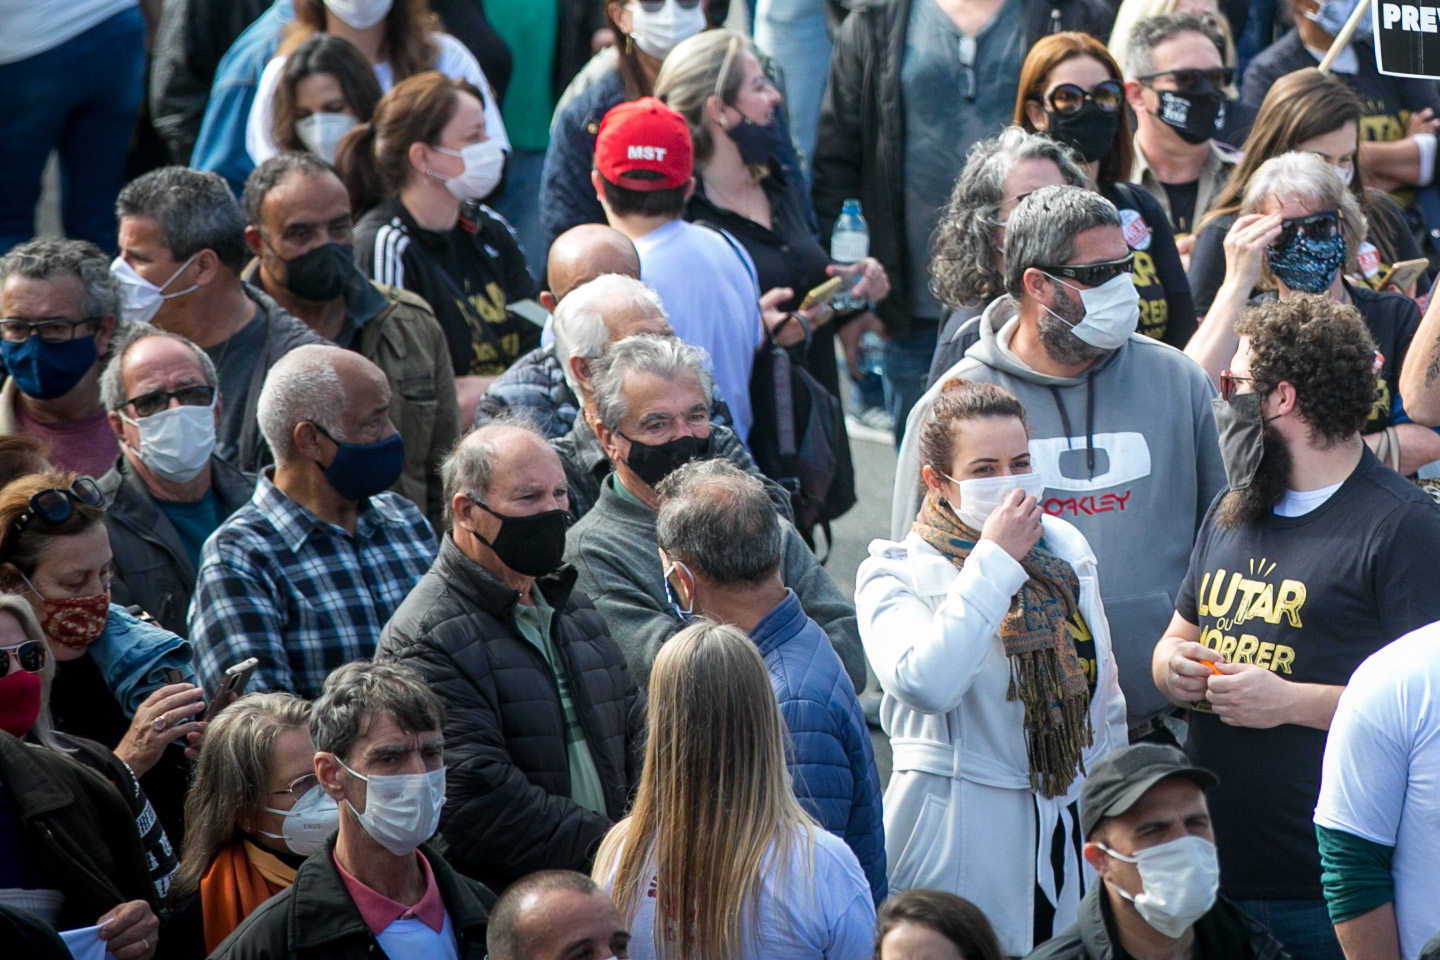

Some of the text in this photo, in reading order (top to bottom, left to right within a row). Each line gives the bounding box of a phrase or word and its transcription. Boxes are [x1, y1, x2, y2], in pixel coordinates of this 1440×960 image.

[627, 145, 667, 162] MST
[1043, 490, 1131, 516] OAKLEY
[1199, 568, 1307, 628] LUTAR
[1216, 617, 1234, 631] OU
